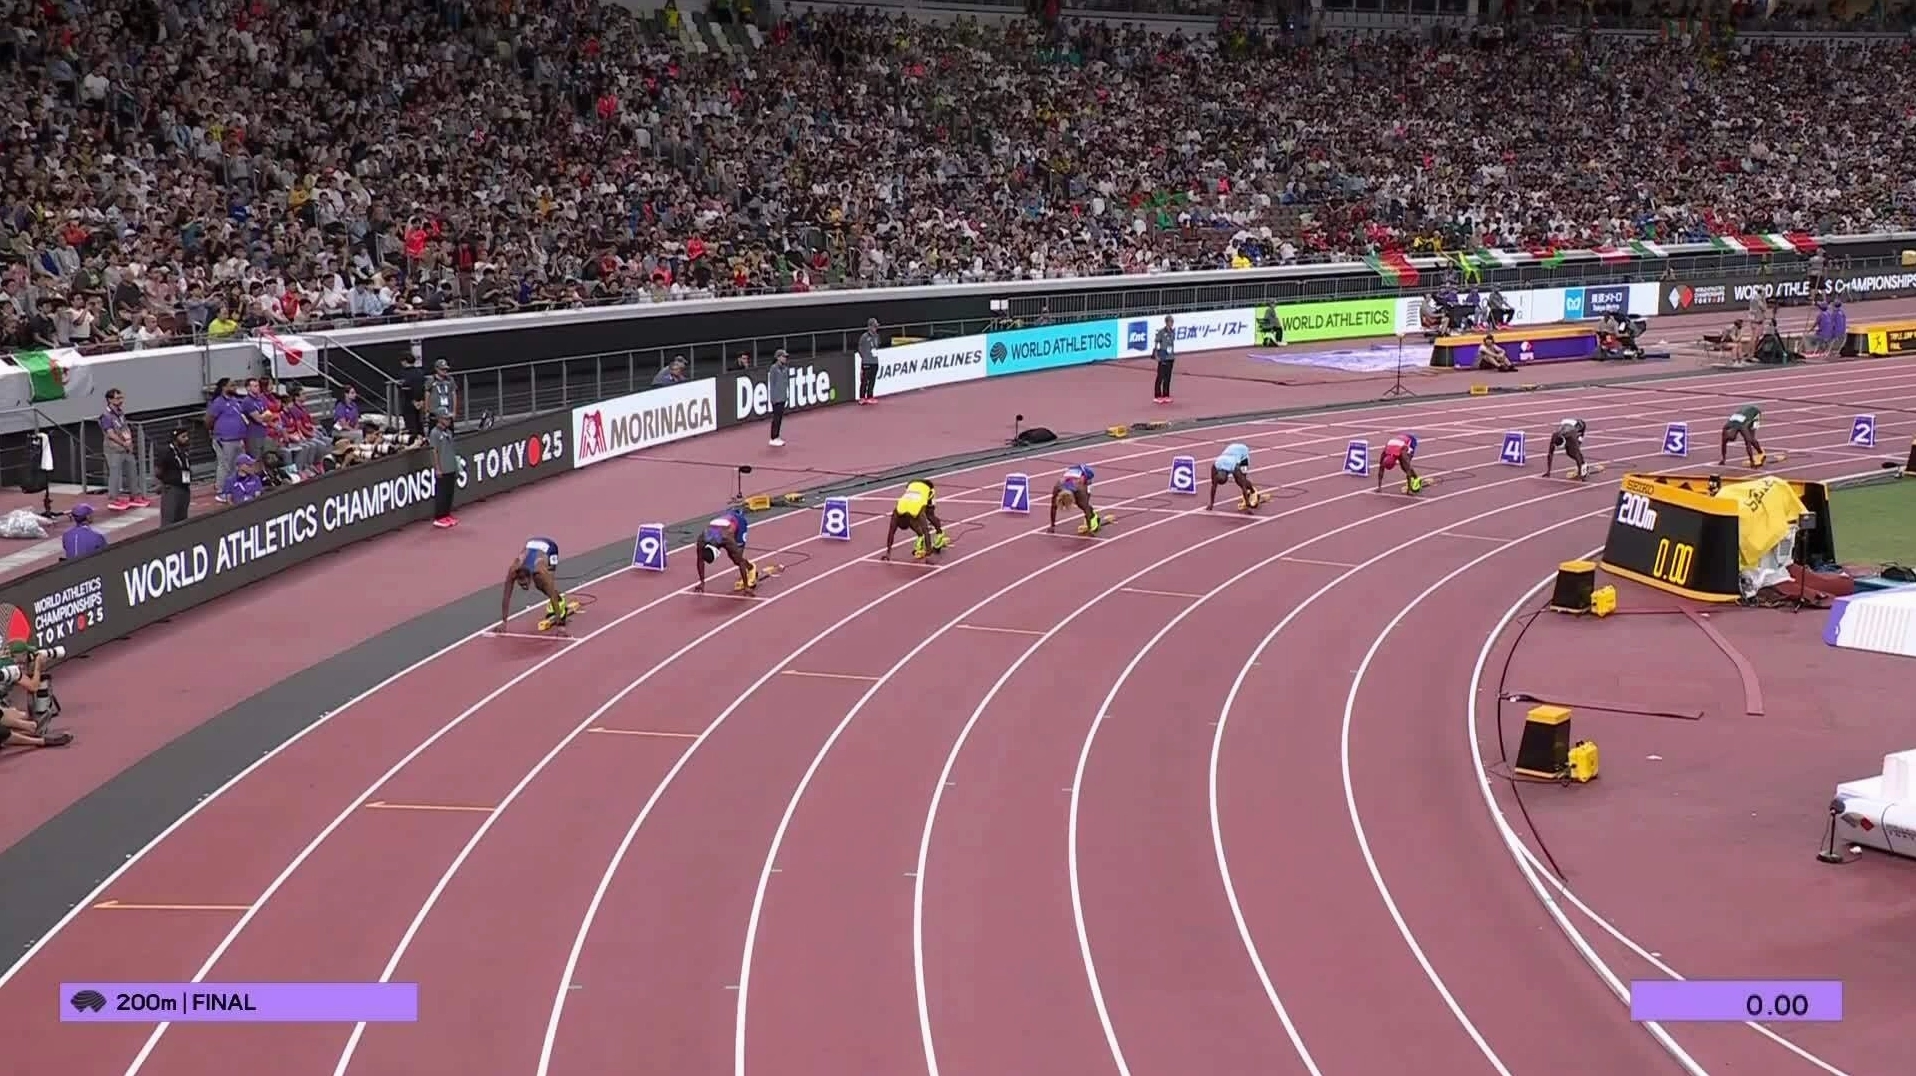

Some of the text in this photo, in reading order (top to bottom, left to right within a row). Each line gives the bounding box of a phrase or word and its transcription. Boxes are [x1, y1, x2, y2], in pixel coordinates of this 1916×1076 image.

[1734, 283, 1773, 301] WORD
[1282, 313, 1326, 331] WORLD
[1326, 309, 1390, 328] ATHLETICS
[1011, 333, 1112, 360] WORLD ATHLETICS
[876, 350, 982, 380] JAPAN AIRLINES
[610, 398, 714, 450] MORINAGA
[1854, 423, 1871, 444] 2
[1505, 440, 1521, 462] 4
[1667, 431, 1684, 451] 3
[1348, 449, 1365, 471] 5
[1173, 466, 1192, 488] 6
[1006, 484, 1025, 508] 7
[826, 508, 845, 534] 8
[1618, 492, 1657, 531] 200m
[123, 544, 209, 607] WORLD
[215, 504, 318, 574] ATHLETICS
[640, 536, 660, 564] 9
[1653, 538, 1694, 585] 0.00
[34, 577, 102, 613] WORLD ATHLETICS
[35, 591, 103, 631] CHAMPIONSHIPS
